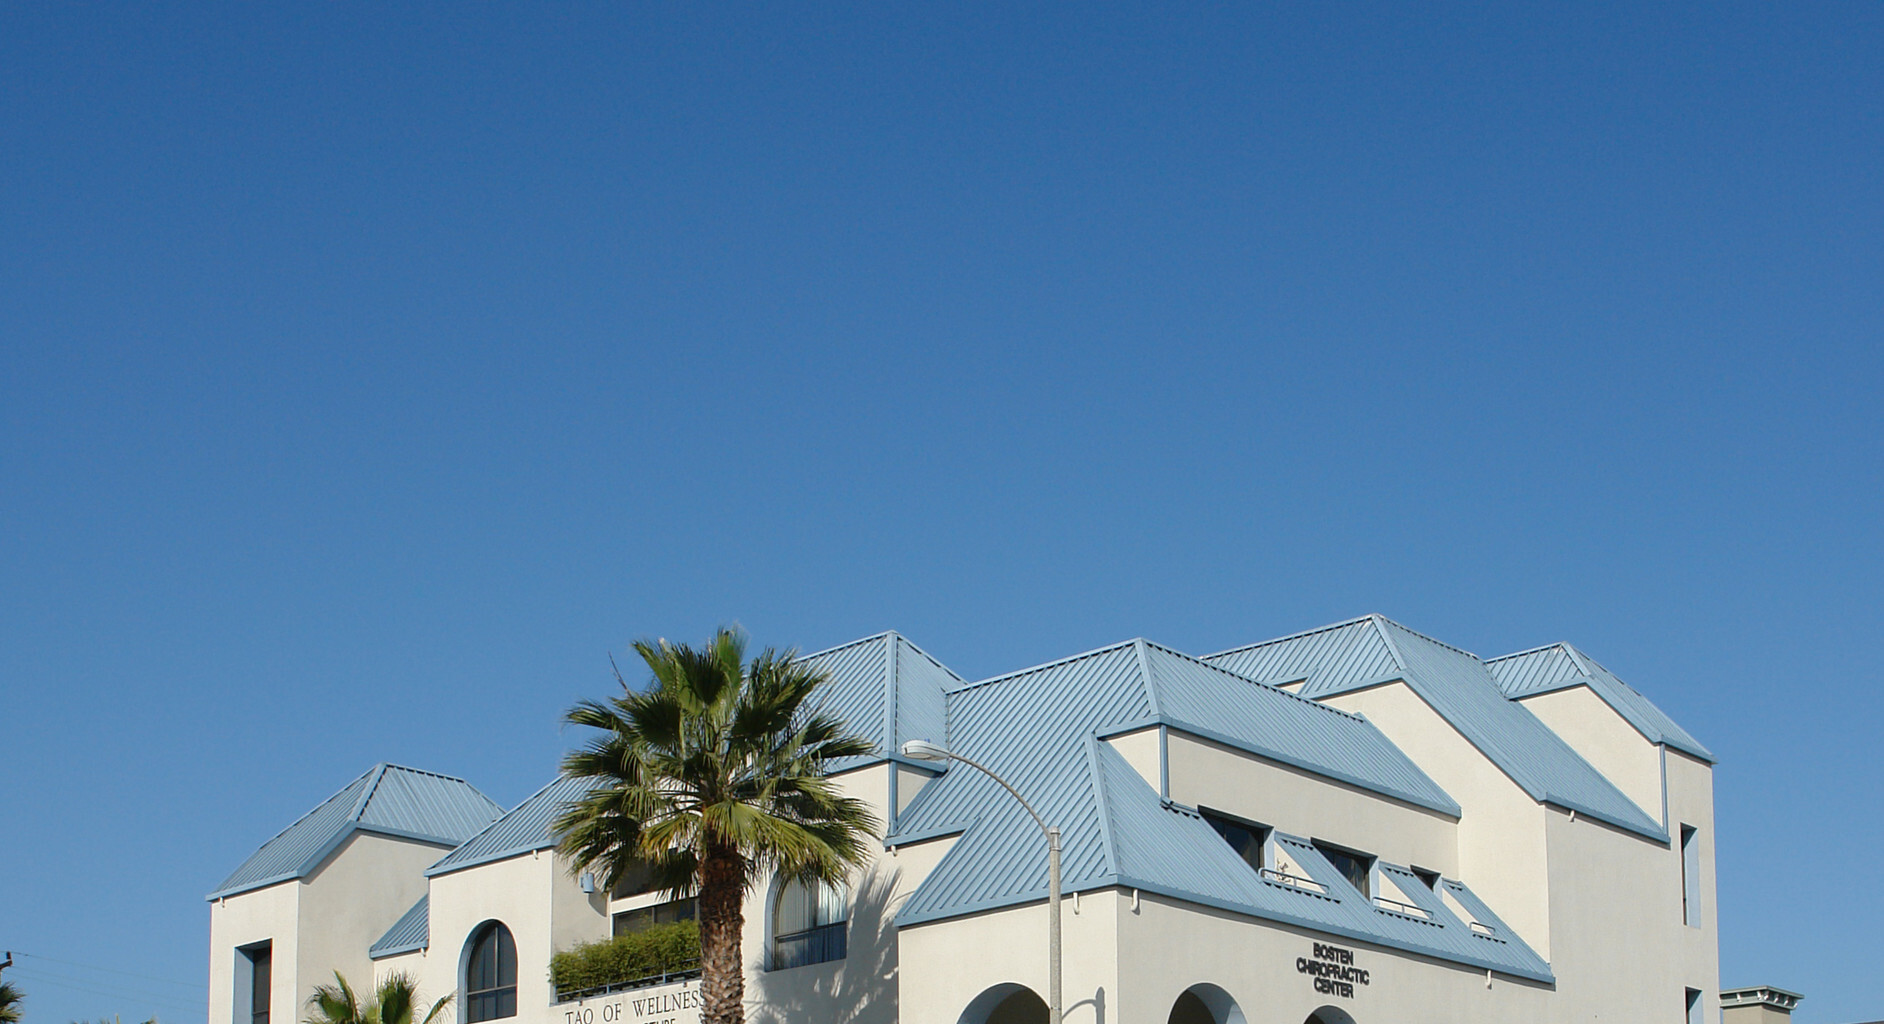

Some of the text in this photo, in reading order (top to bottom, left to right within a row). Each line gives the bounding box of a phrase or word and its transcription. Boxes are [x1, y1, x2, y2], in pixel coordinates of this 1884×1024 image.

[1313, 942, 1354, 966] BOSTEN
[1296, 957, 1370, 986] CHIROPRACTIC
[1314, 977, 1354, 999] CENTER
[603, 1003, 621, 1022] OF
